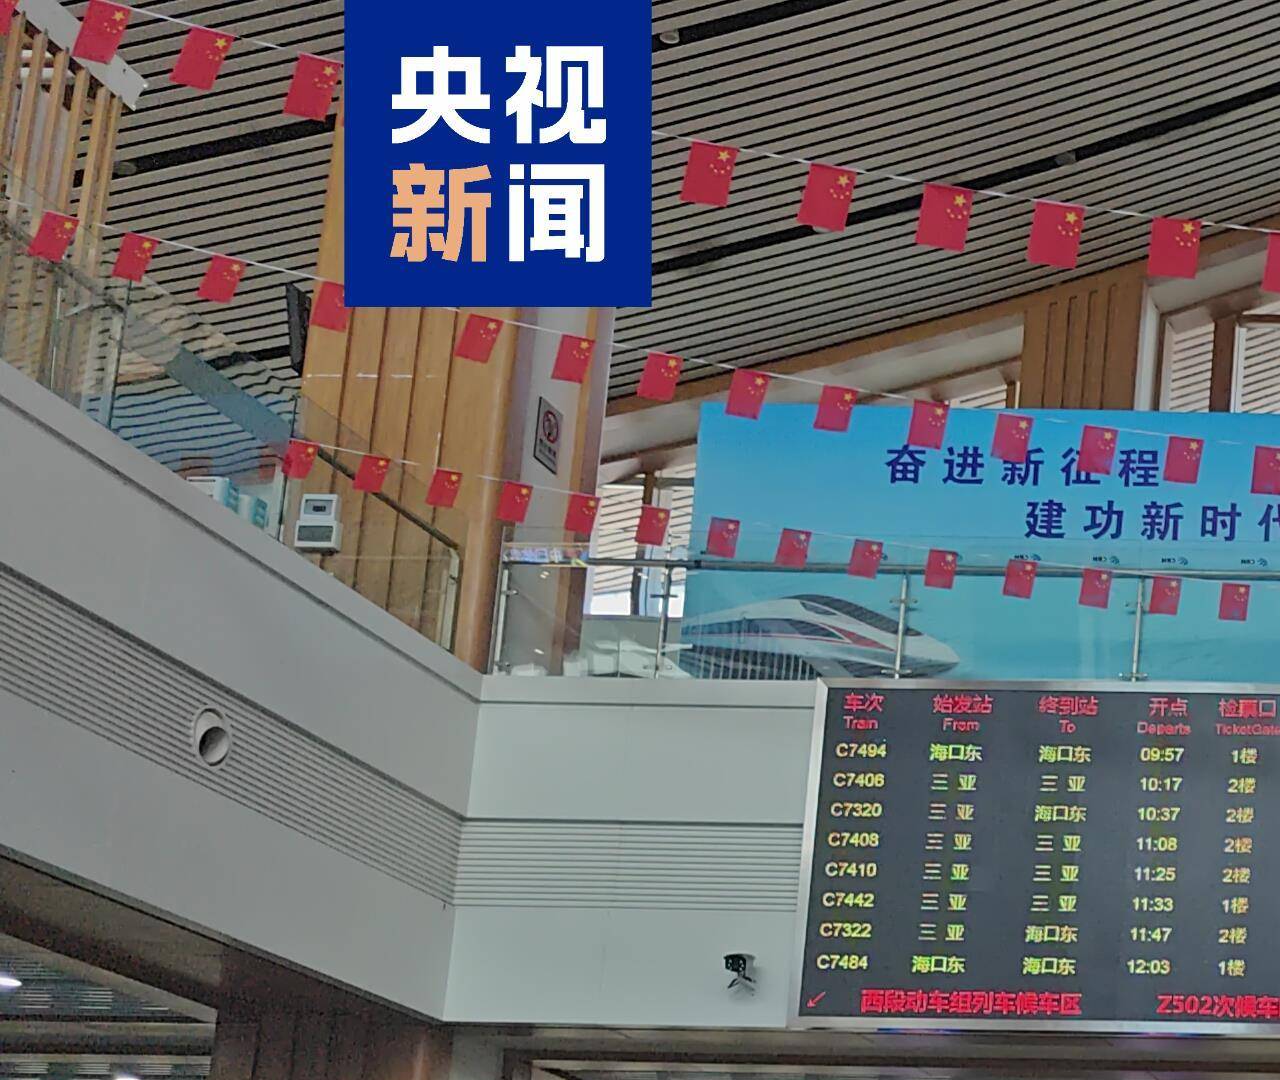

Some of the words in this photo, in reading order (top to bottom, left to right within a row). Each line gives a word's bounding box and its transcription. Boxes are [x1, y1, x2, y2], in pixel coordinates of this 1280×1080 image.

[885, 444, 1159, 487] 奋进新征程
[843, 694, 884, 713] 车次
[933, 696, 993, 715] 始发站
[1038, 697, 1098, 716] 终到站
[1149, 698, 1188, 716] 开点
[1218, 699, 1277, 718] 检票口
[843, 716, 878, 730] Train
[943, 719, 980, 732] From
[1059, 720, 1076, 733] To
[1137, 722, 1191, 736] Departs
[835, 744, 887, 758] C7494
[930, 744, 982, 762] 海口东
[1039, 745, 1092, 764] 海口东
[1140, 747, 1184, 762] 09:57
[1231, 747, 1258, 765] 1楼
[832, 773, 885, 787] C7406
[1139, 777, 1183, 791] 10:17
[1228, 777, 1256, 795] 2楼
[830, 803, 882, 818] C7320
[1034, 805, 1086, 823] 海口东
[1137, 806, 1180, 821] 10:37
[1226, 807, 1254, 825] 2楼
[828, 832, 879, 848] C7408
[1137, 836, 1177, 852] 11:08
[1224, 837, 1252, 855] 2楼
[825, 862, 877, 877] C7410
[1134, 866, 1176, 882] 11:25
[1222, 867, 1251, 884] 2楼
[822, 892, 874, 907] C7442
[1132, 896, 1174, 912] 11:33
[1222, 897, 1249, 915] 1楼
[819, 922, 872, 938] C7322
[1026, 925, 1078, 943] 海口东
[1130, 926, 1172, 942] 11:47
[1218, 927, 1246, 945] 2楼
[816, 955, 868, 971] C7484
[912, 955, 965, 974] 海口东
[1023, 956, 1076, 975] 海口东
[1127, 959, 1171, 974] 12:03
[1218, 959, 1245, 977] 1楼
[861, 989, 1082, 1016] 西段动车组列车候车区
